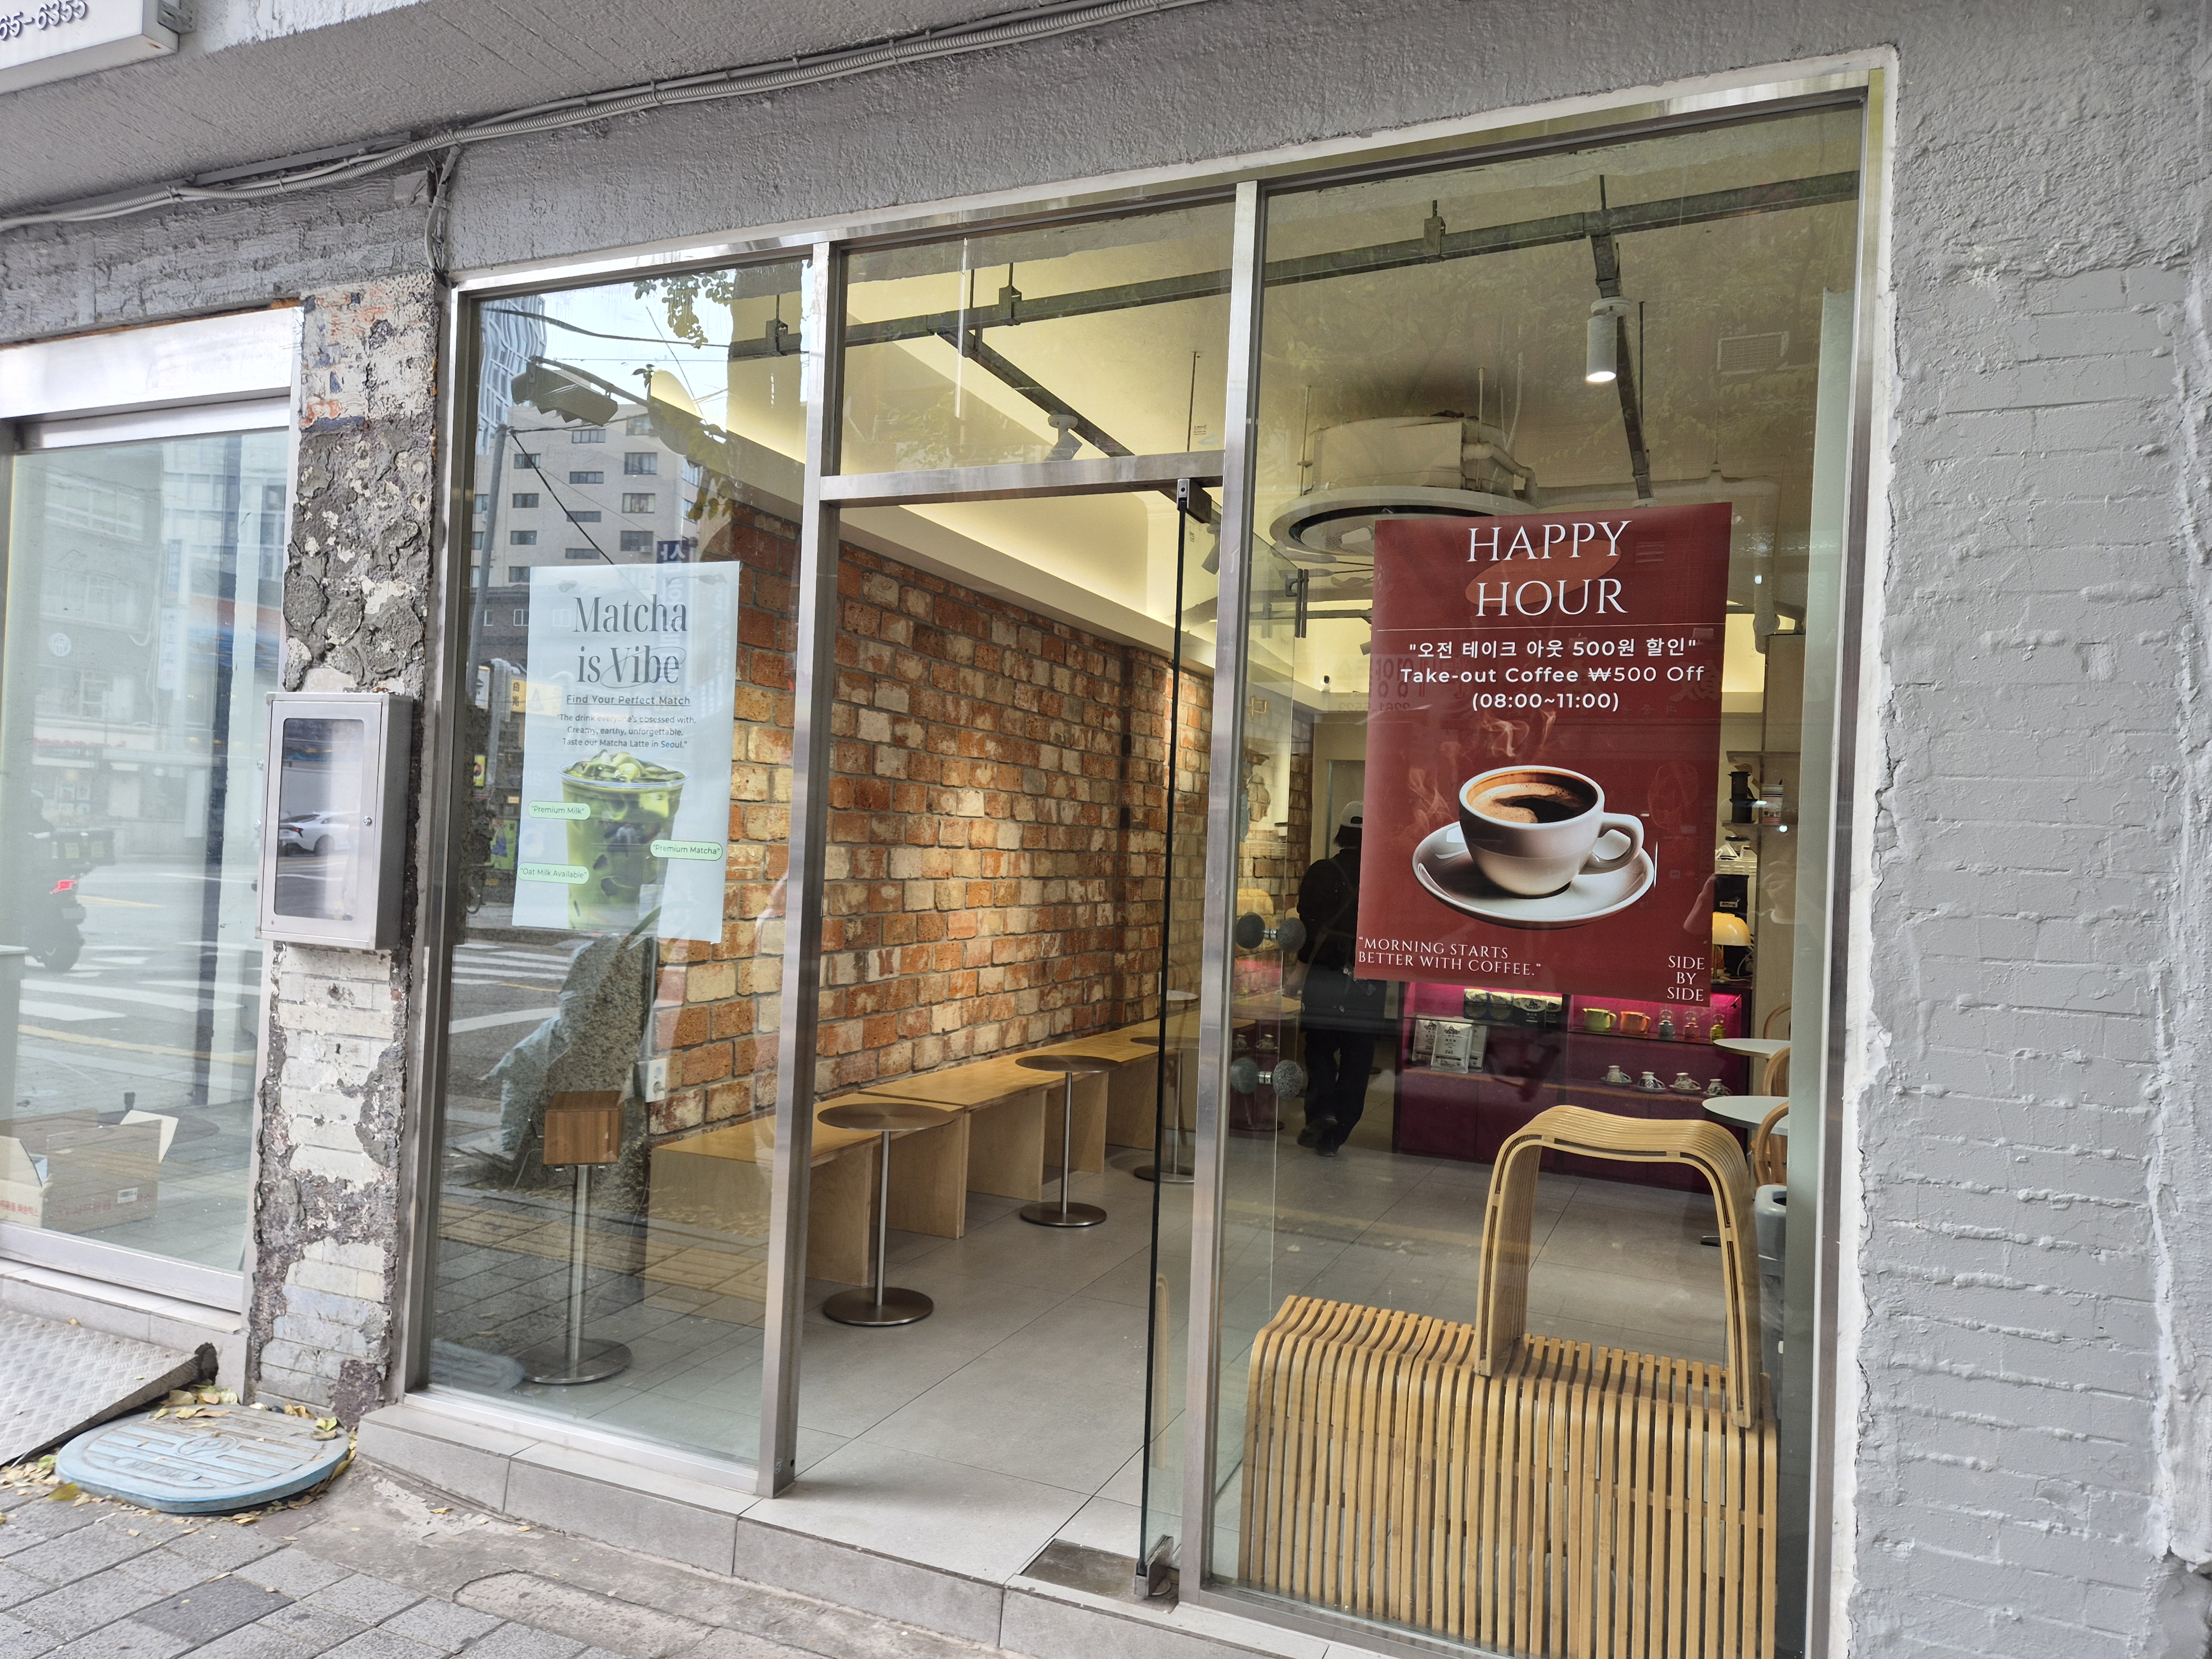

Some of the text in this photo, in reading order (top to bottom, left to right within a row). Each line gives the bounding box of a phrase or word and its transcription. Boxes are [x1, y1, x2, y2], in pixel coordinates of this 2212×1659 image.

[1467, 520, 1632, 562] HAPPY
[1475, 578, 1628, 617] HOUR
[573, 594, 686, 632] Matcha
[1410, 638, 1696, 659] "오전 테이크 아웃 500원 할인"
[576, 645, 680, 684] is Vibe
[1400, 665, 1704, 684] Take-out Coffee ₩500 Off
[566, 695, 588, 704] Find
[592, 695, 613, 705] Your
[618, 695, 655, 705] Perfect
[659, 696, 690, 705] Match
[1472, 693, 1619, 712] (08:00~11:00)
[597, 714, 637, 724] everyone's
[639, 716, 675, 724] obsessed
[567, 726, 684, 738] Creamy, earthy, unforgettable.
[531, 805, 585, 815] "Premium Milk"
[653, 844, 721, 855] "Premium Matcha"
[520, 868, 535, 876] "Oat
[553, 870, 587, 879] Available"
[1451, 943, 1509, 959] STARTS
[1358, 951, 1415, 967] BETTER
[1420, 956, 1462, 971] WITH
[1668, 955, 1705, 971] SIDE
[1676, 971, 1697, 985] BY
[1667, 986, 1704, 1002] SIDE
